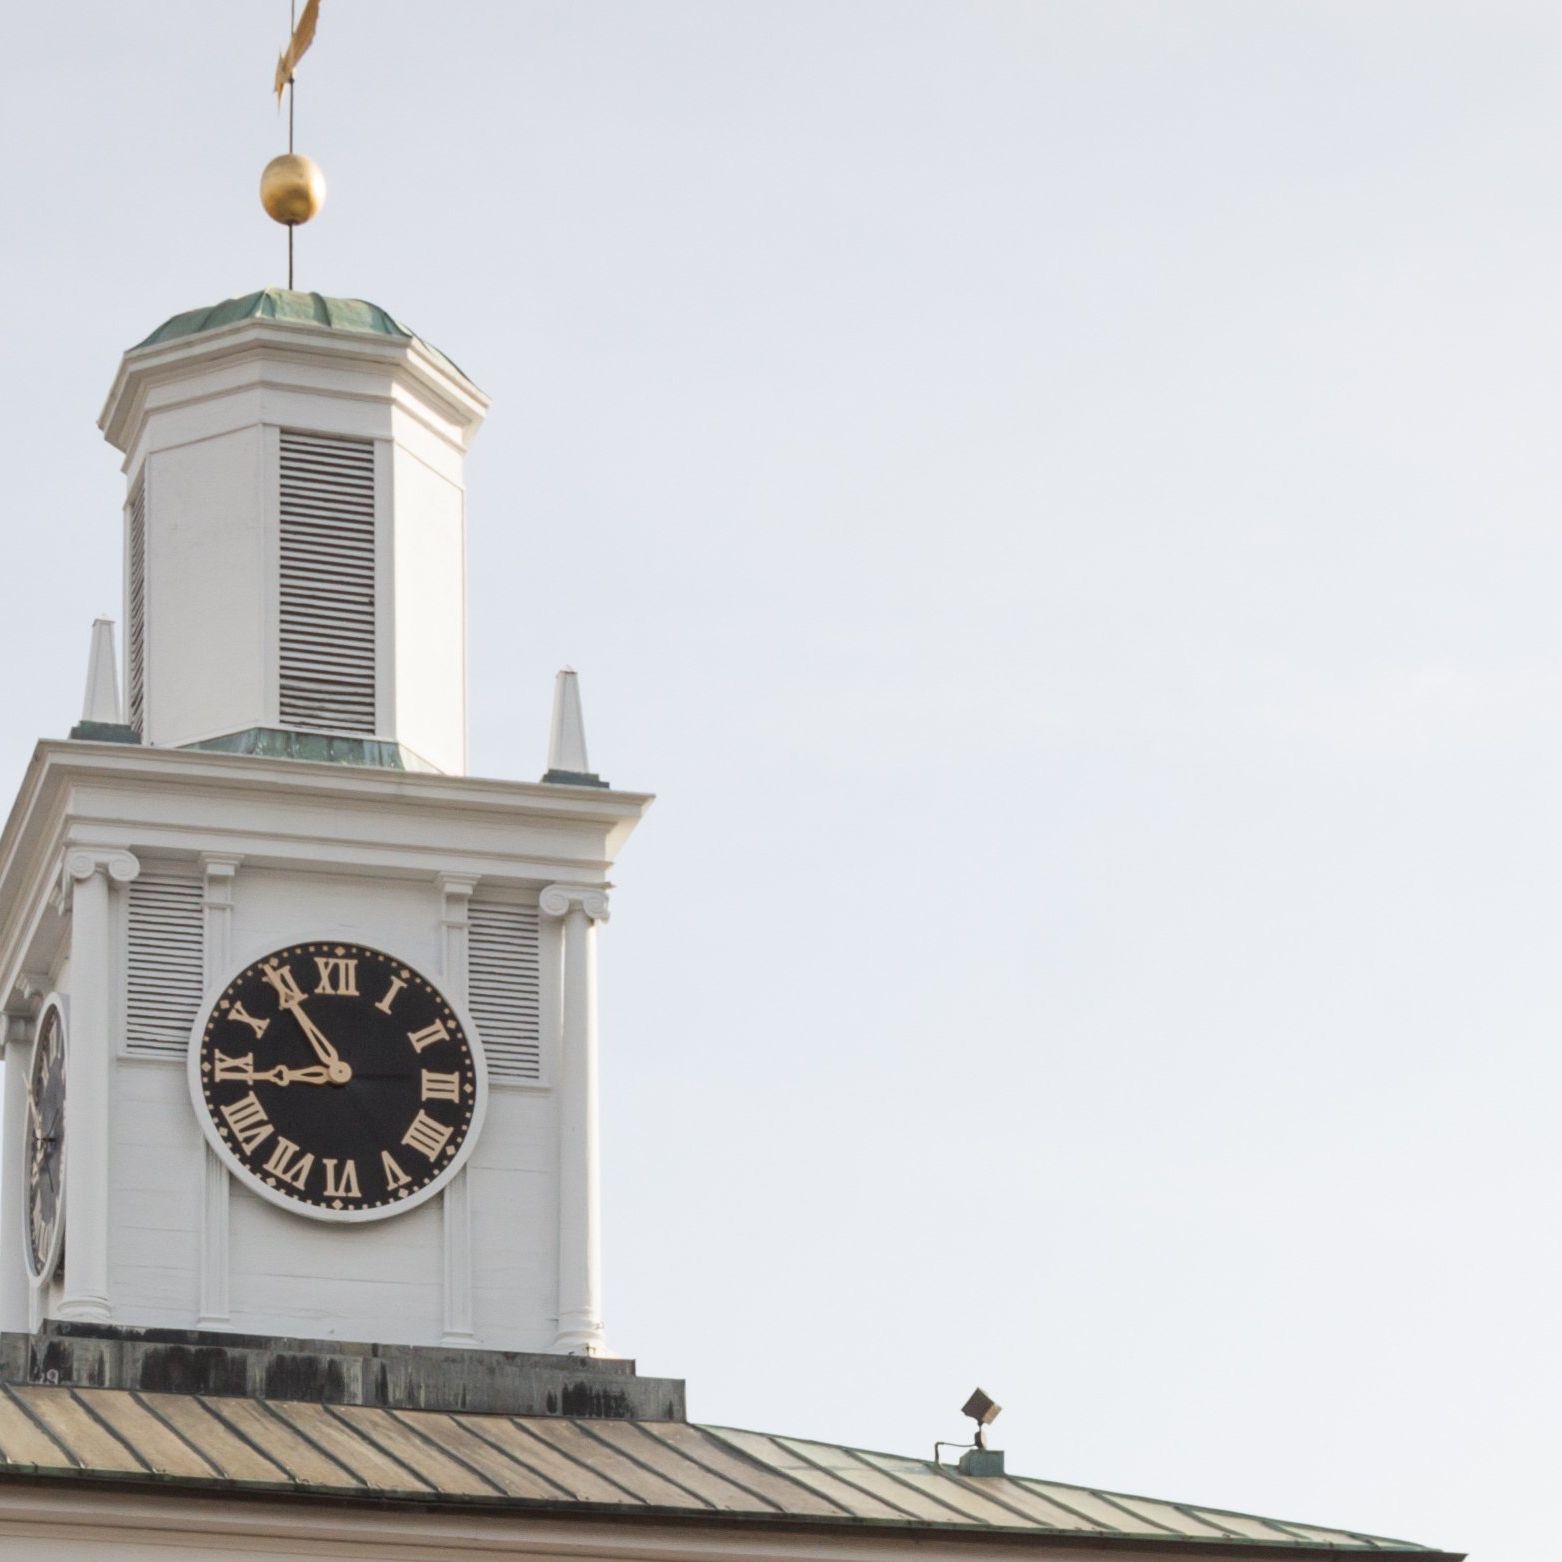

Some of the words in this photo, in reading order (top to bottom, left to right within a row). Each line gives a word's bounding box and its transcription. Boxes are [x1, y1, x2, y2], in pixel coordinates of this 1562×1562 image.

[314, 957, 359, 996] XII
[375, 976, 407, 1014] I
[228, 1001, 270, 1039] X
[407, 1018, 450, 1053] II
[421, 1069, 459, 1103] III
[220, 1091, 275, 1156] VIII
[401, 1109, 454, 1162] IIII
[263, 1135, 315, 1191] VII
[323, 1158, 362, 1197] VI
[382, 1150, 411, 1191] V
